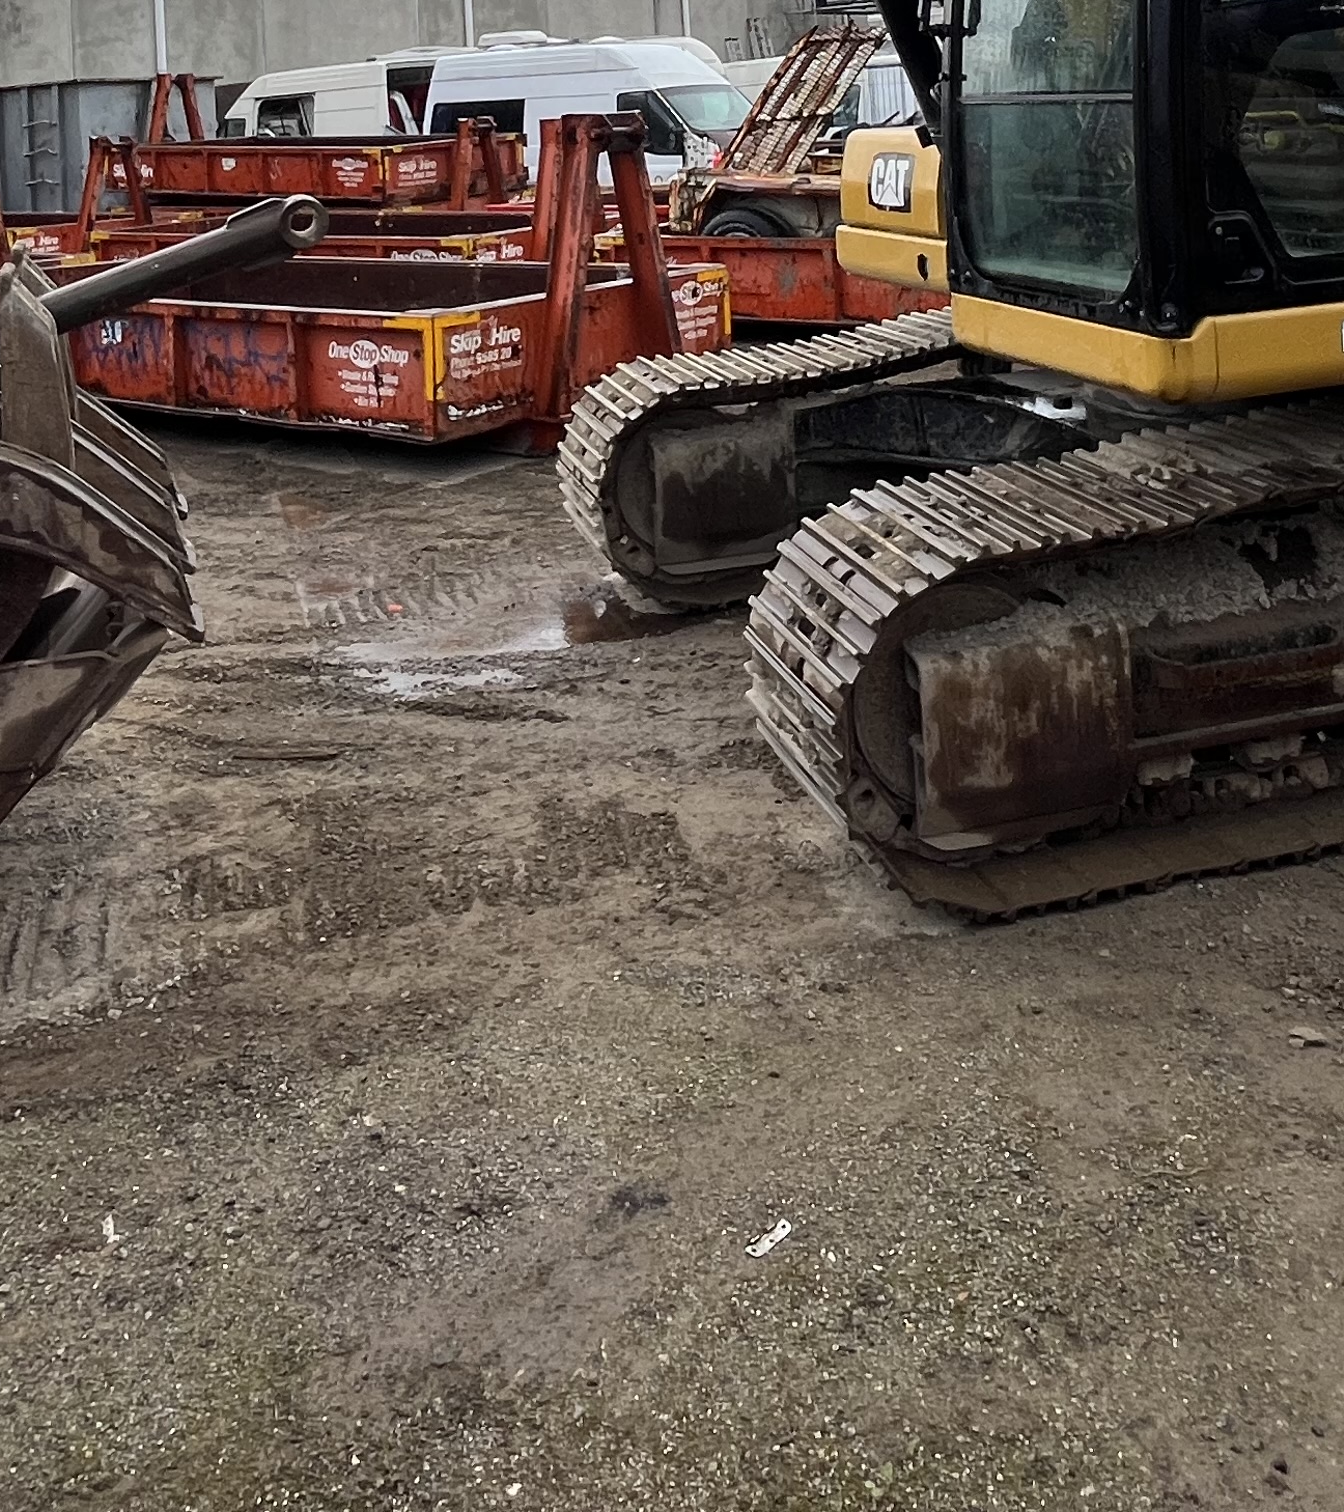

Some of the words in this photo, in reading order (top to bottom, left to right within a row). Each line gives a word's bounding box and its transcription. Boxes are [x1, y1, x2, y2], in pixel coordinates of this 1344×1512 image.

[870, 157, 910, 207] CAT
[329, 340, 349, 359] One
[352, 343, 377, 364] Stop
[380, 344, 409, 368] Shop
[450, 332, 482, 355] Skip
[490, 325, 521, 346] Hire
